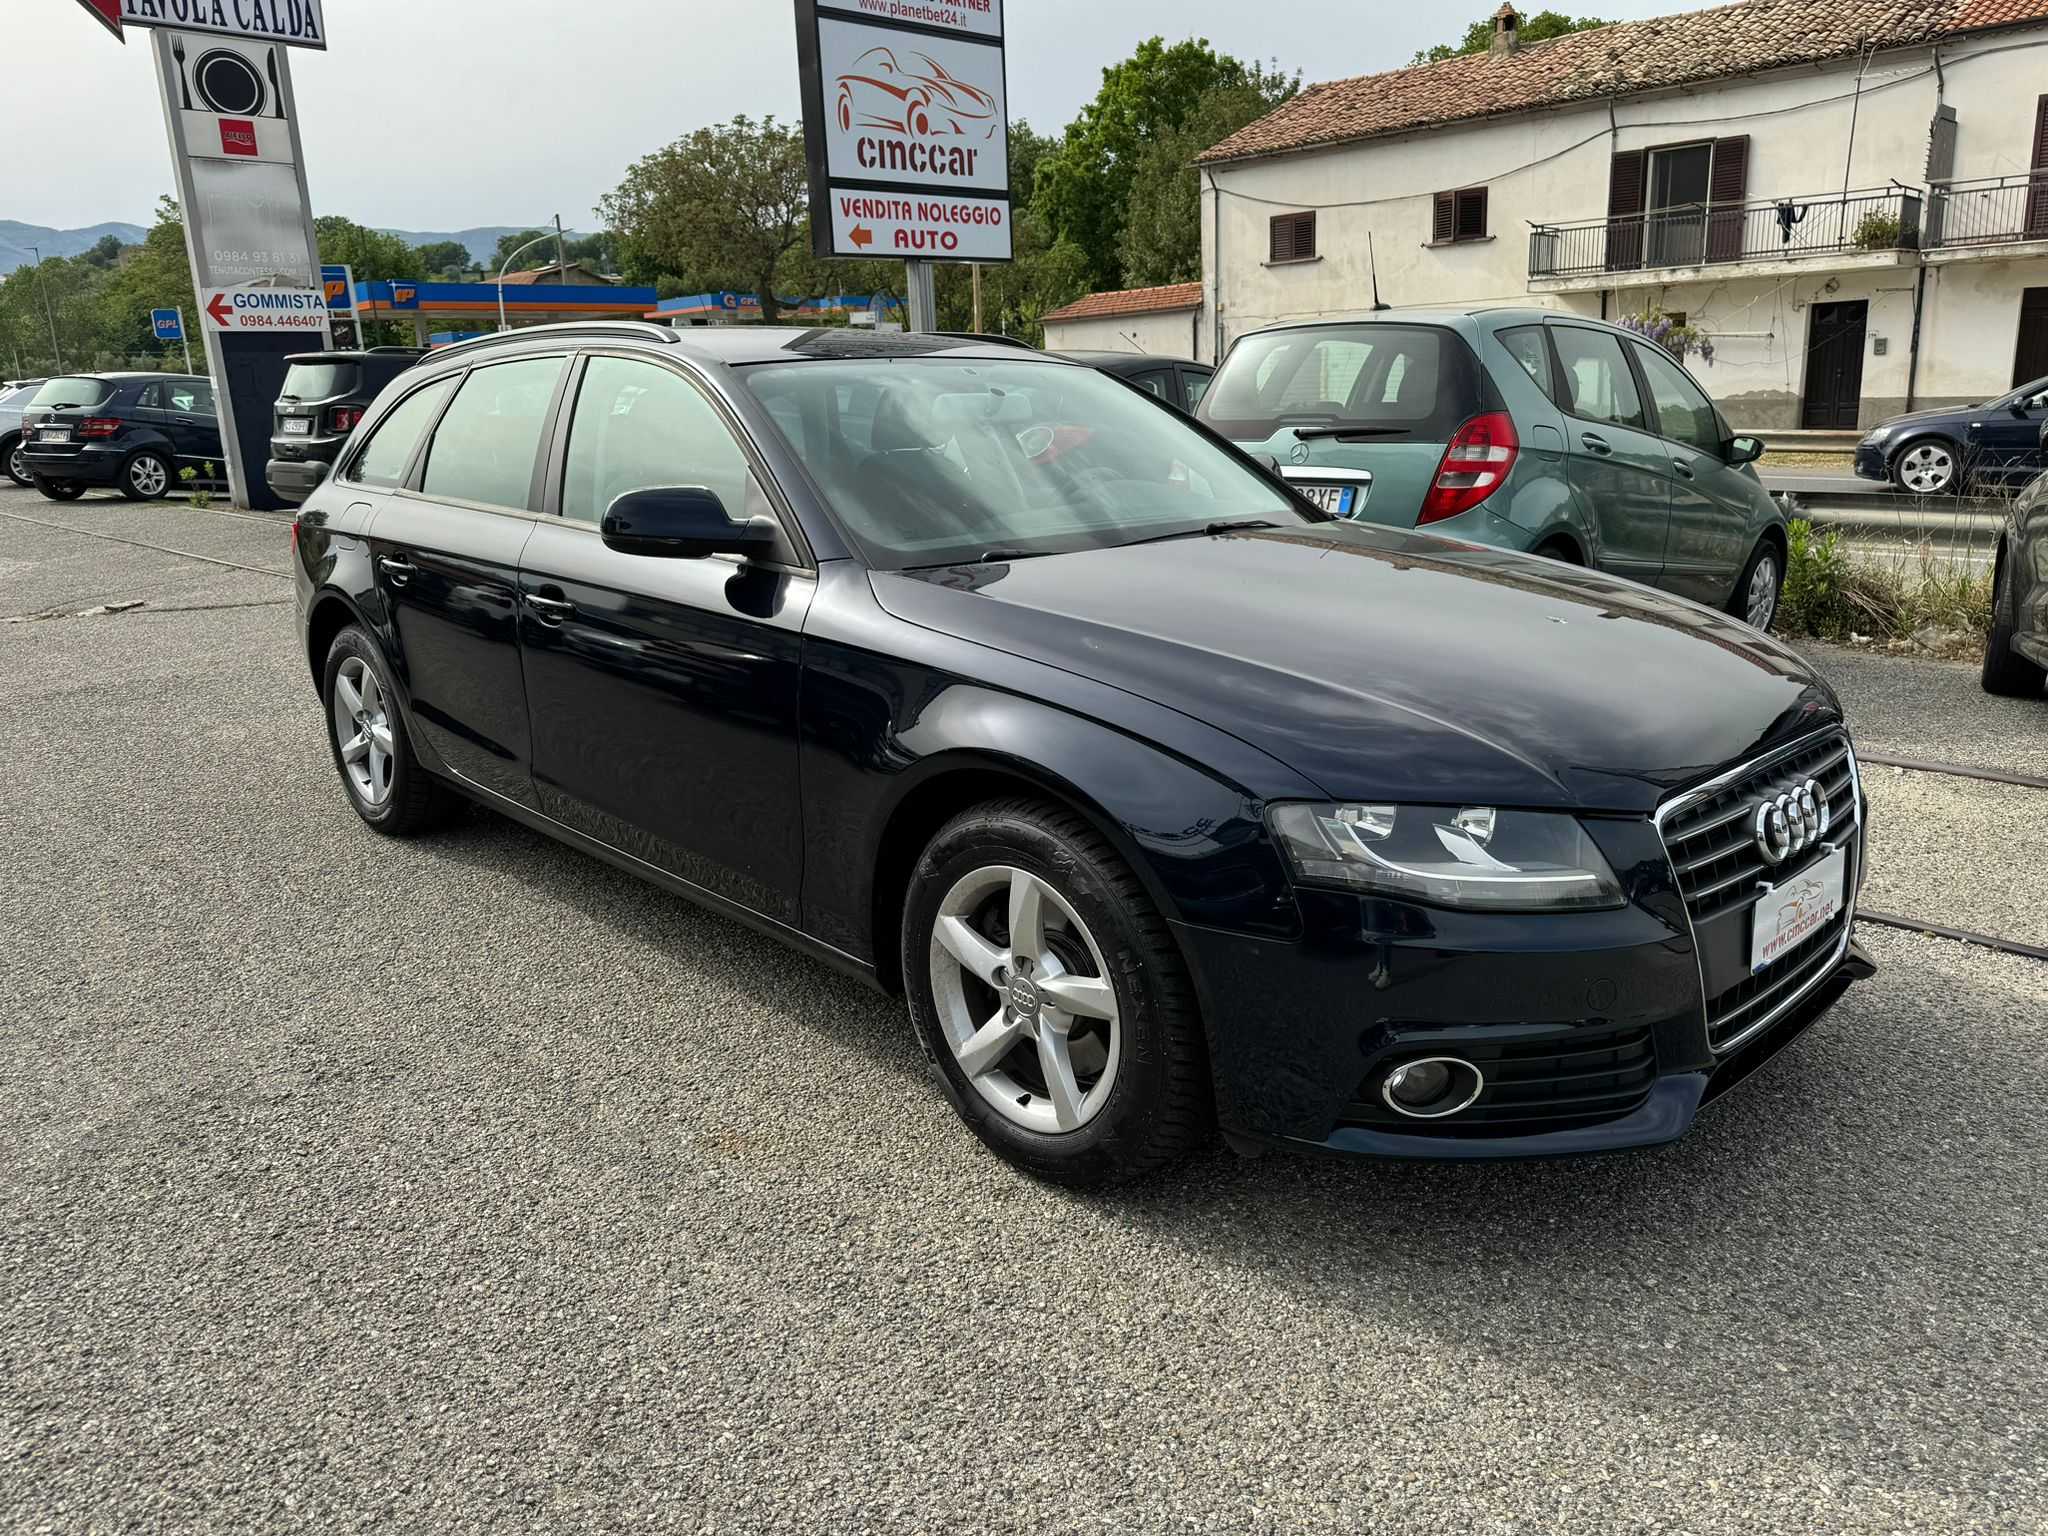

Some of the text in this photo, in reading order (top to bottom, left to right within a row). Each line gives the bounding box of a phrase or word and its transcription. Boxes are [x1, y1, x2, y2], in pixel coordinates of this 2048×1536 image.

[234, 0, 320, 40] CALDA
[859, 0, 967, 28] www.planetbet24.it
[840, 197, 1001, 226] VENDITA NOLEGGIO
[894, 229, 958, 250] AUTO
[233, 293, 325, 310] GOMMISTA
[156, 319, 179, 329] GPL
[240, 314, 323, 327] 0984.446407
[1297, 488, 1340, 511] 8XF
